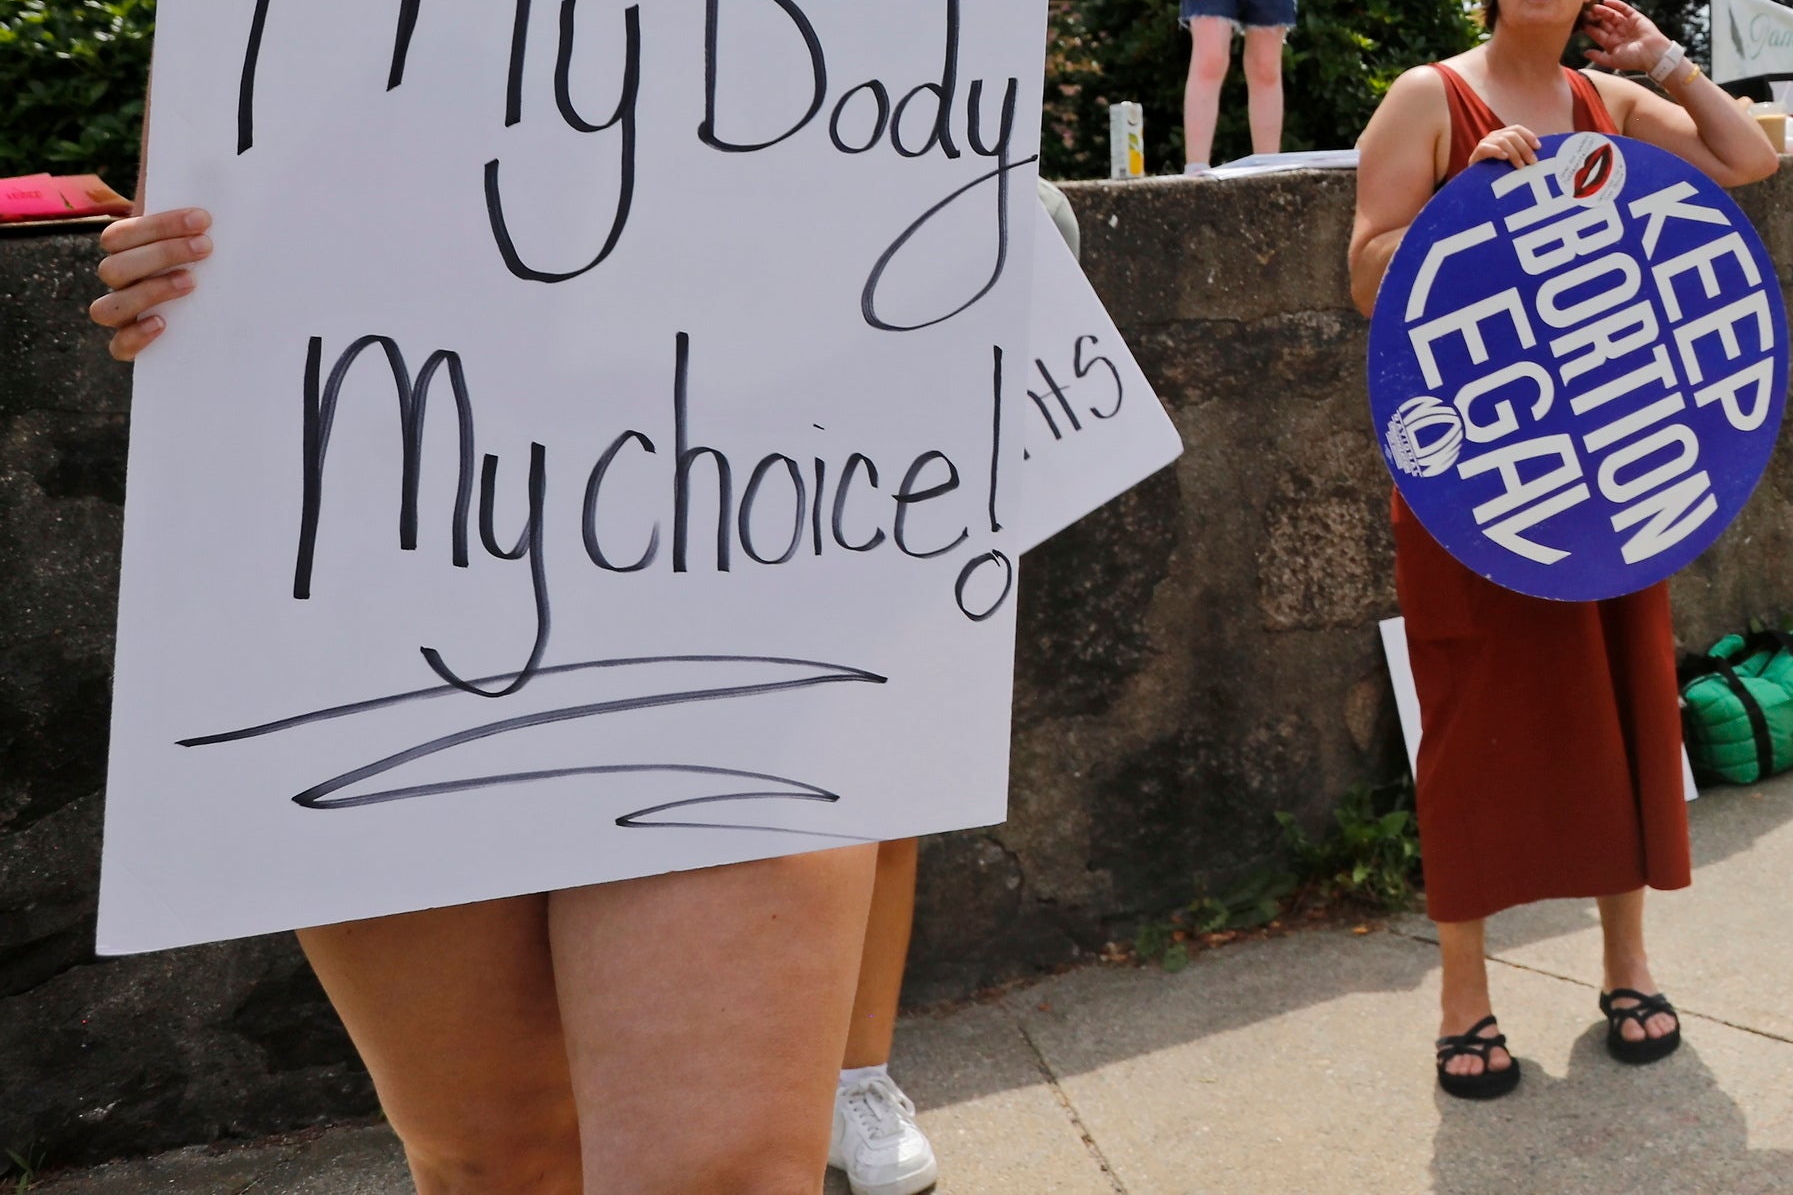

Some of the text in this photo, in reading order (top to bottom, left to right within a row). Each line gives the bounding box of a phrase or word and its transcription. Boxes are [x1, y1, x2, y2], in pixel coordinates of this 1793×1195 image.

[1404, 221, 1591, 566] LEGAL
[1627, 180, 1775, 432] KEEP
[292, 330, 1013, 698] My choice!
